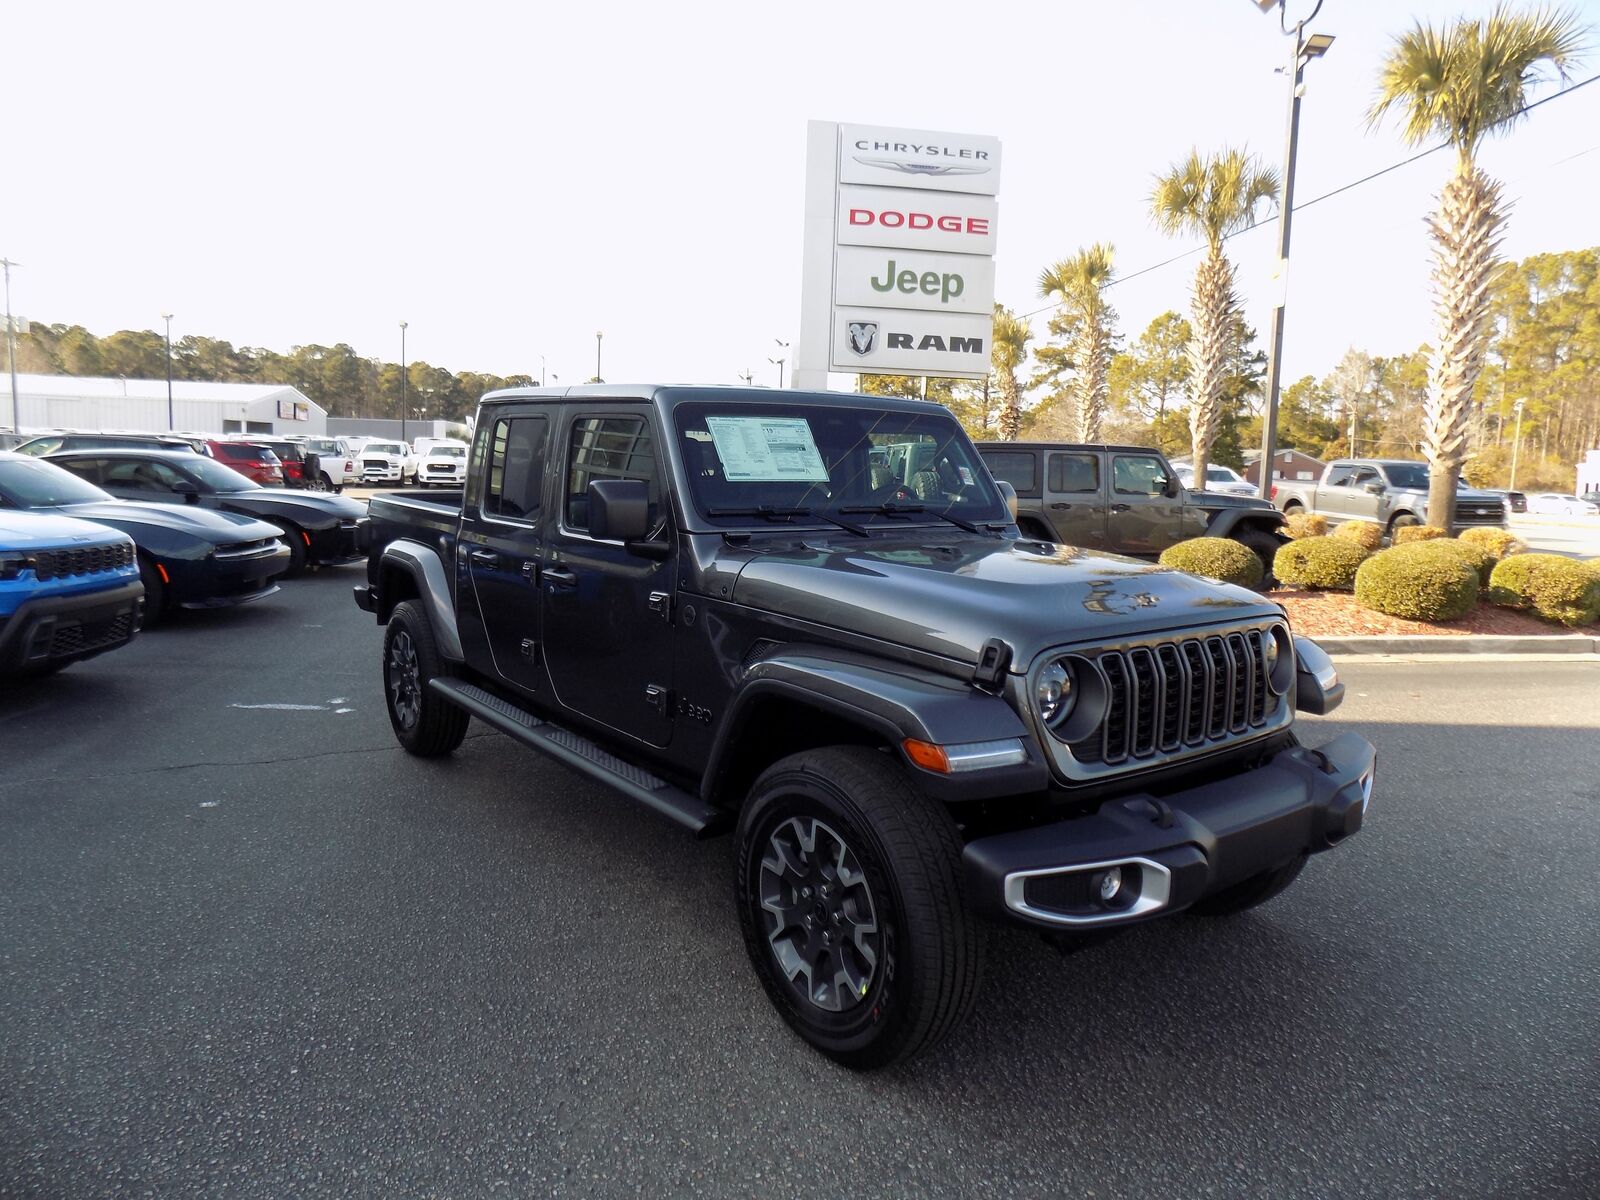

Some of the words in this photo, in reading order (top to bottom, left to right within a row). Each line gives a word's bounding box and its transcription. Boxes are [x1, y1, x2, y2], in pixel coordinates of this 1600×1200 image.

[855, 140, 989, 160] CHRYSLER
[849, 208, 989, 235] DODGE
[870, 260, 964, 303] Jeep
[887, 332, 983, 354] RAM
[678, 697, 712, 723] Jeep
